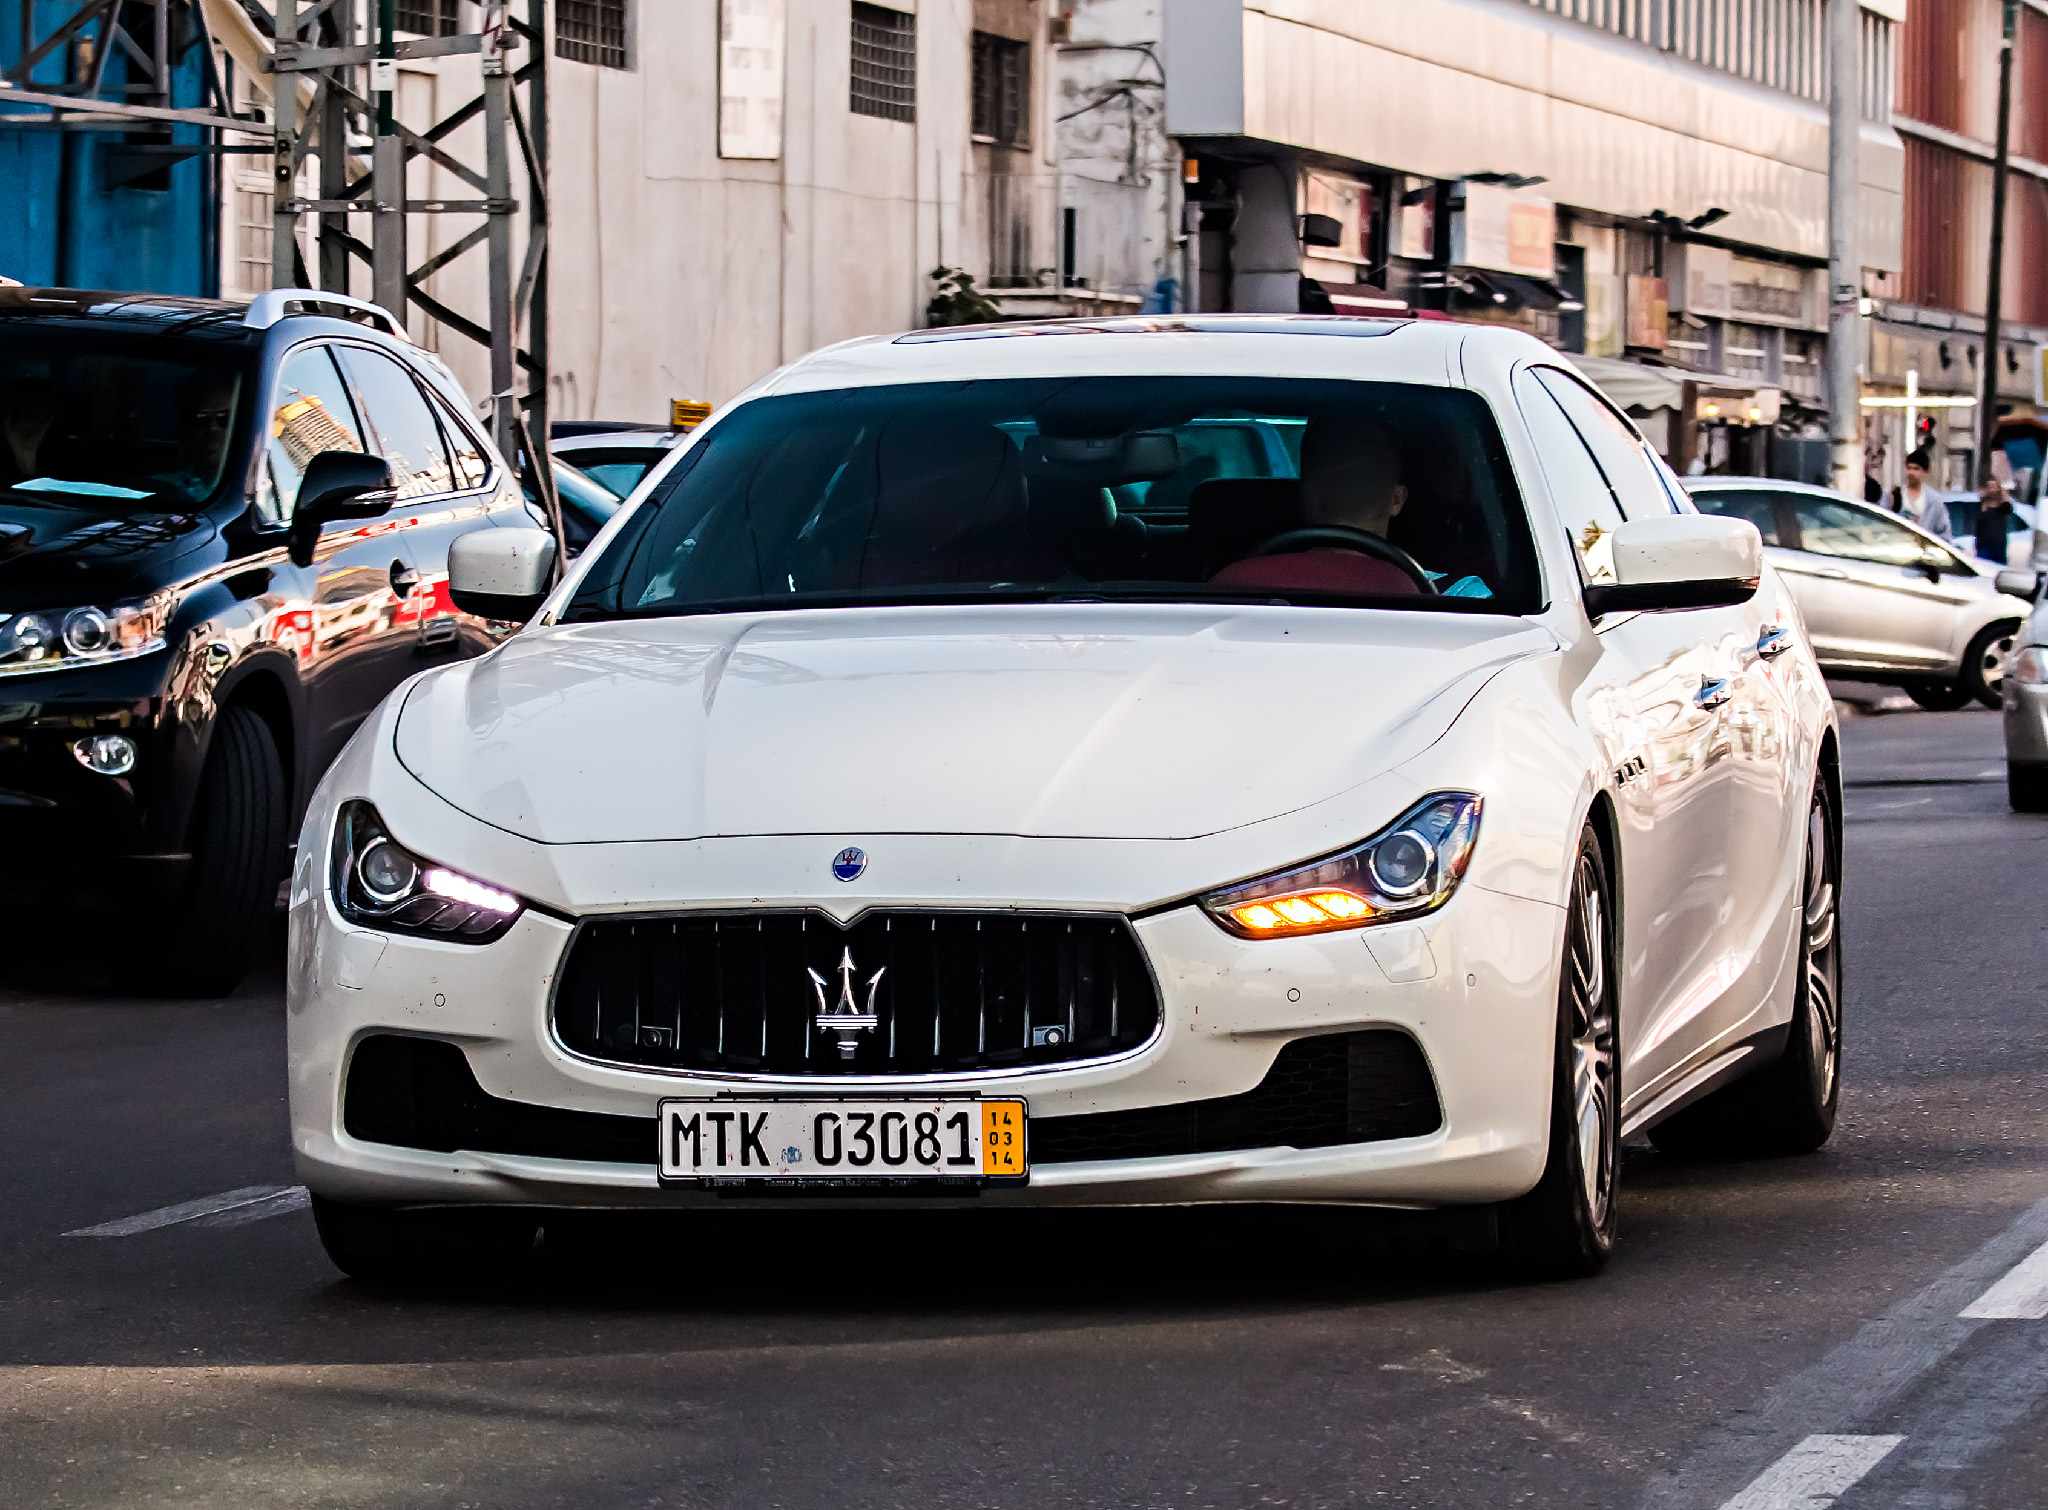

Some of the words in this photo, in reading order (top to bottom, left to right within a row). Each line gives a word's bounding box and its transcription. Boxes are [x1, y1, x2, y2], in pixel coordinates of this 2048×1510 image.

[990, 1111, 1013, 1126] 14
[671, 1111, 771, 1167] MTK
[813, 1111, 976, 1167] 03081
[989, 1131, 1013, 1146] 03
[991, 1151, 1013, 1166] 14
